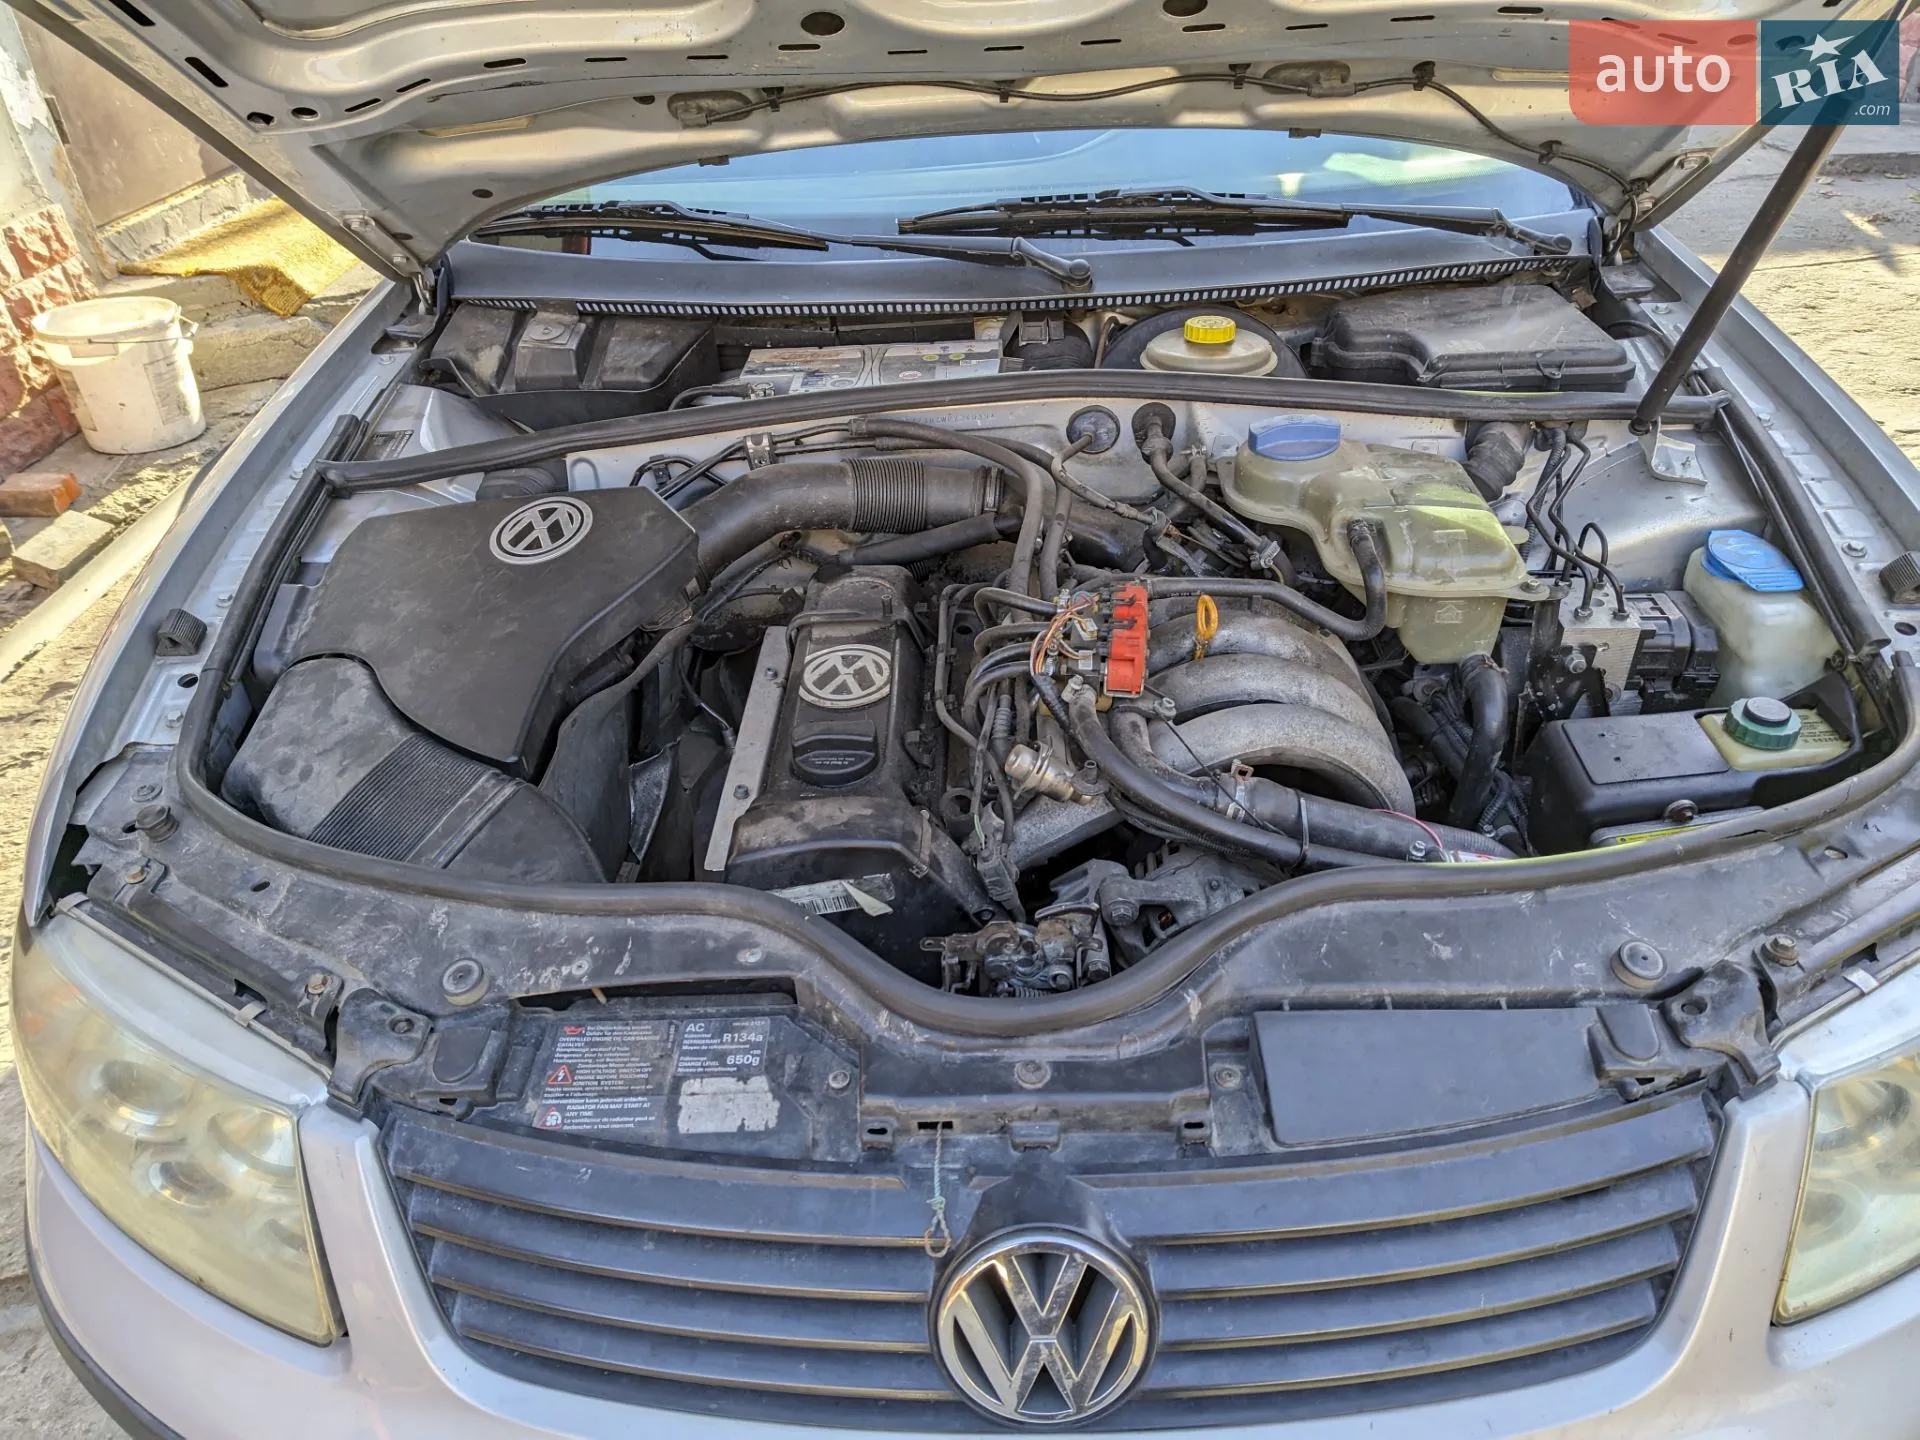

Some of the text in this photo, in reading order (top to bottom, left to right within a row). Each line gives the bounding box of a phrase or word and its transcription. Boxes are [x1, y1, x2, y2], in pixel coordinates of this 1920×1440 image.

[685, 1023, 705, 1032] AC
[722, 1032, 764, 1043] R134a
[726, 1054, 760, 1067] 650g
